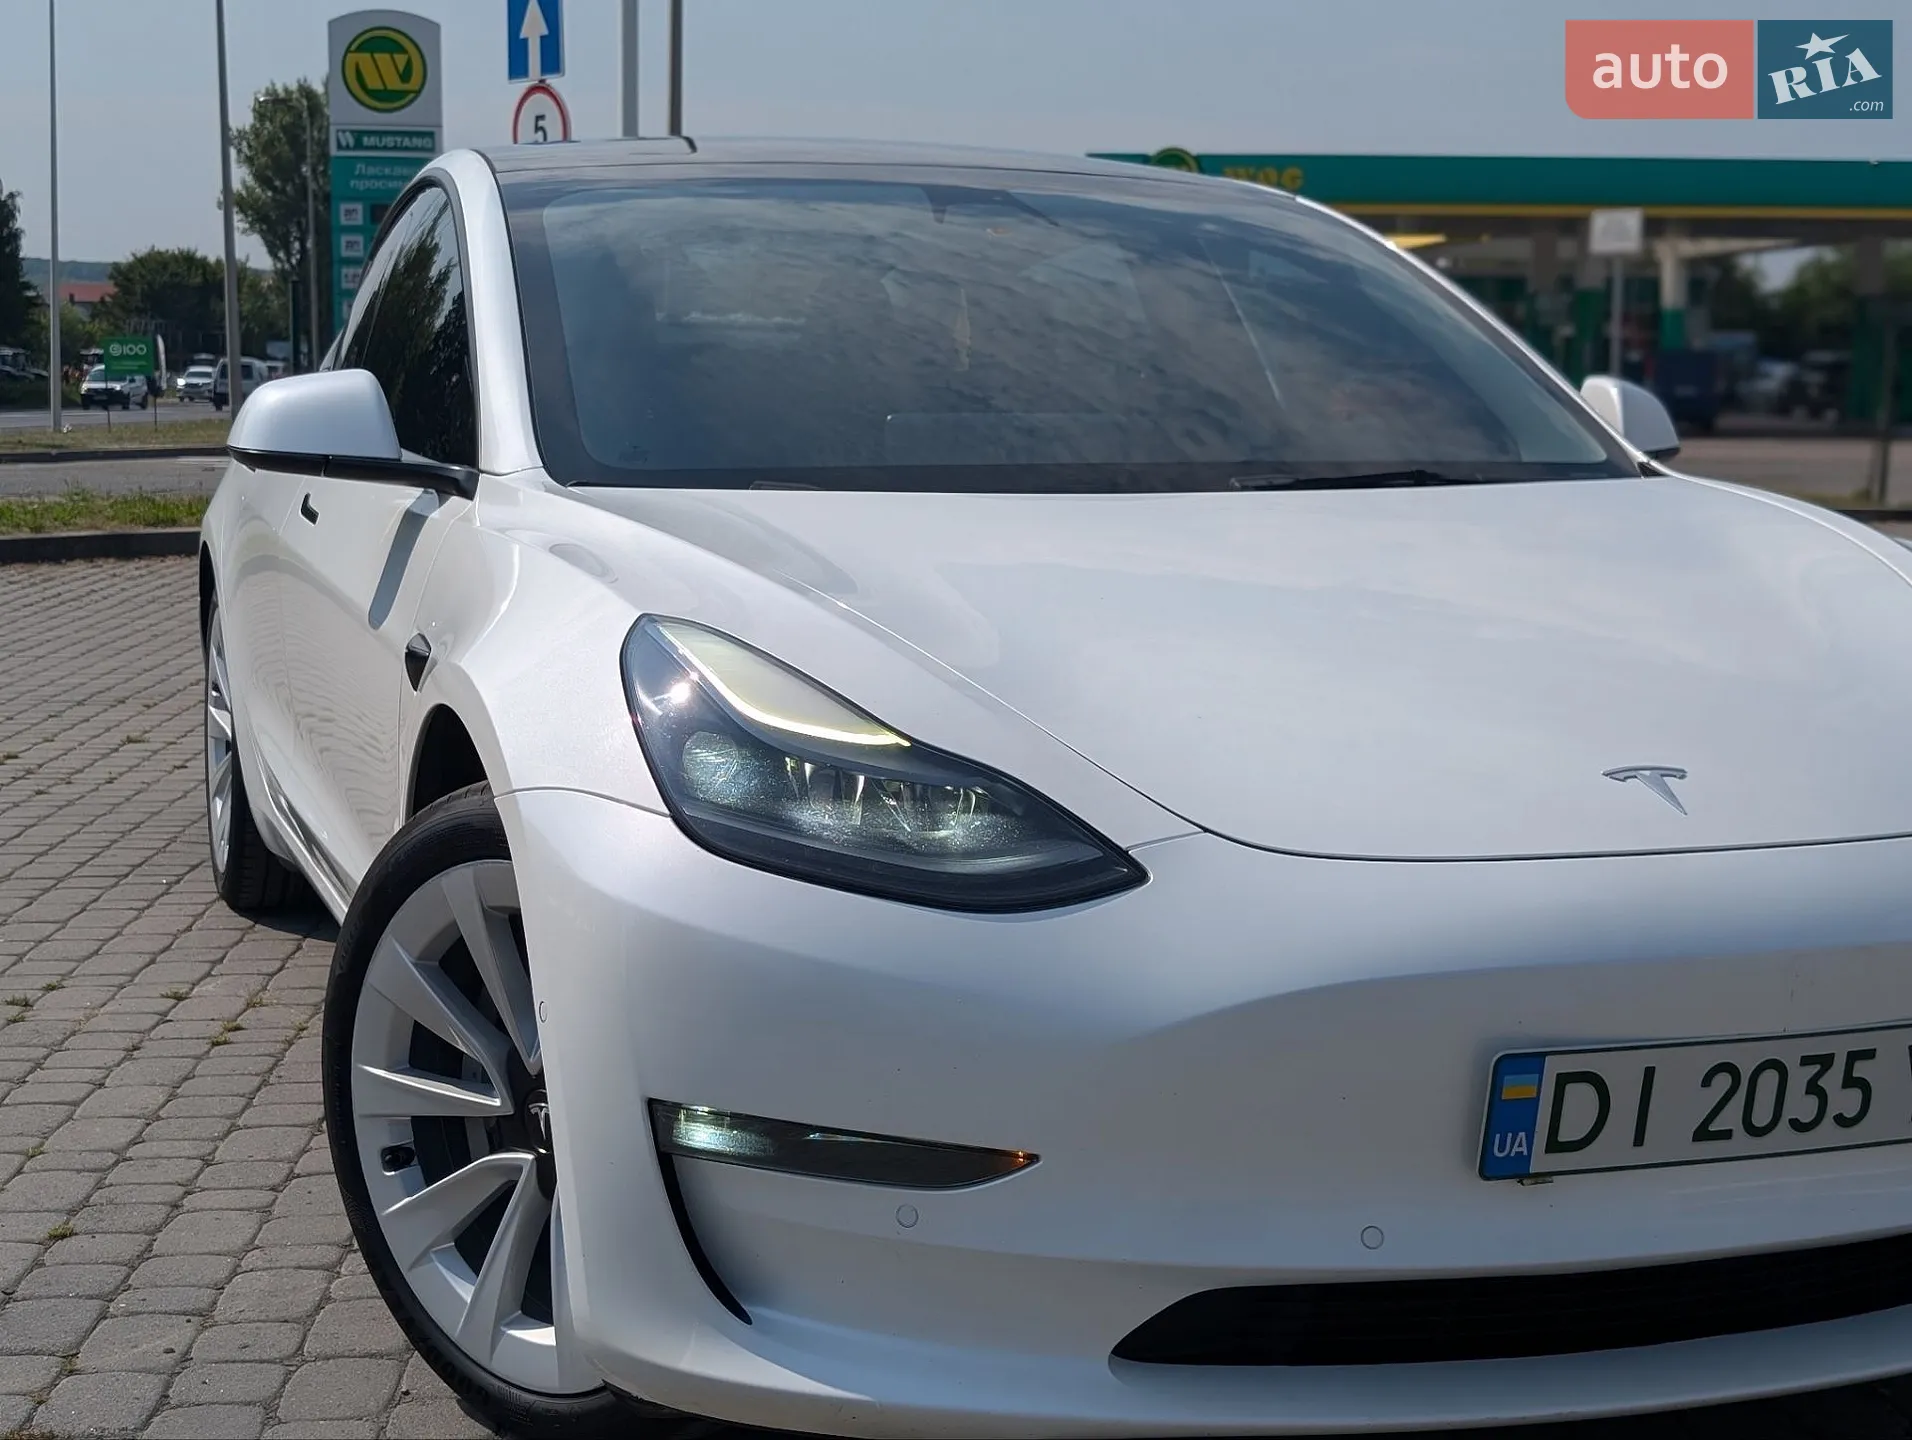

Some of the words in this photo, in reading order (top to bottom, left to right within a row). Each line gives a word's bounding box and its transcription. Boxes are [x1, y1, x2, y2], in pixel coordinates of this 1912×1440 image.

[362, 136, 432, 149] MUSTANG
[534, 114, 548, 143] 5
[1544, 1066, 1656, 1154] DI
[1690, 1047, 1877, 1143] 2035
[1493, 1131, 1528, 1158] UA
